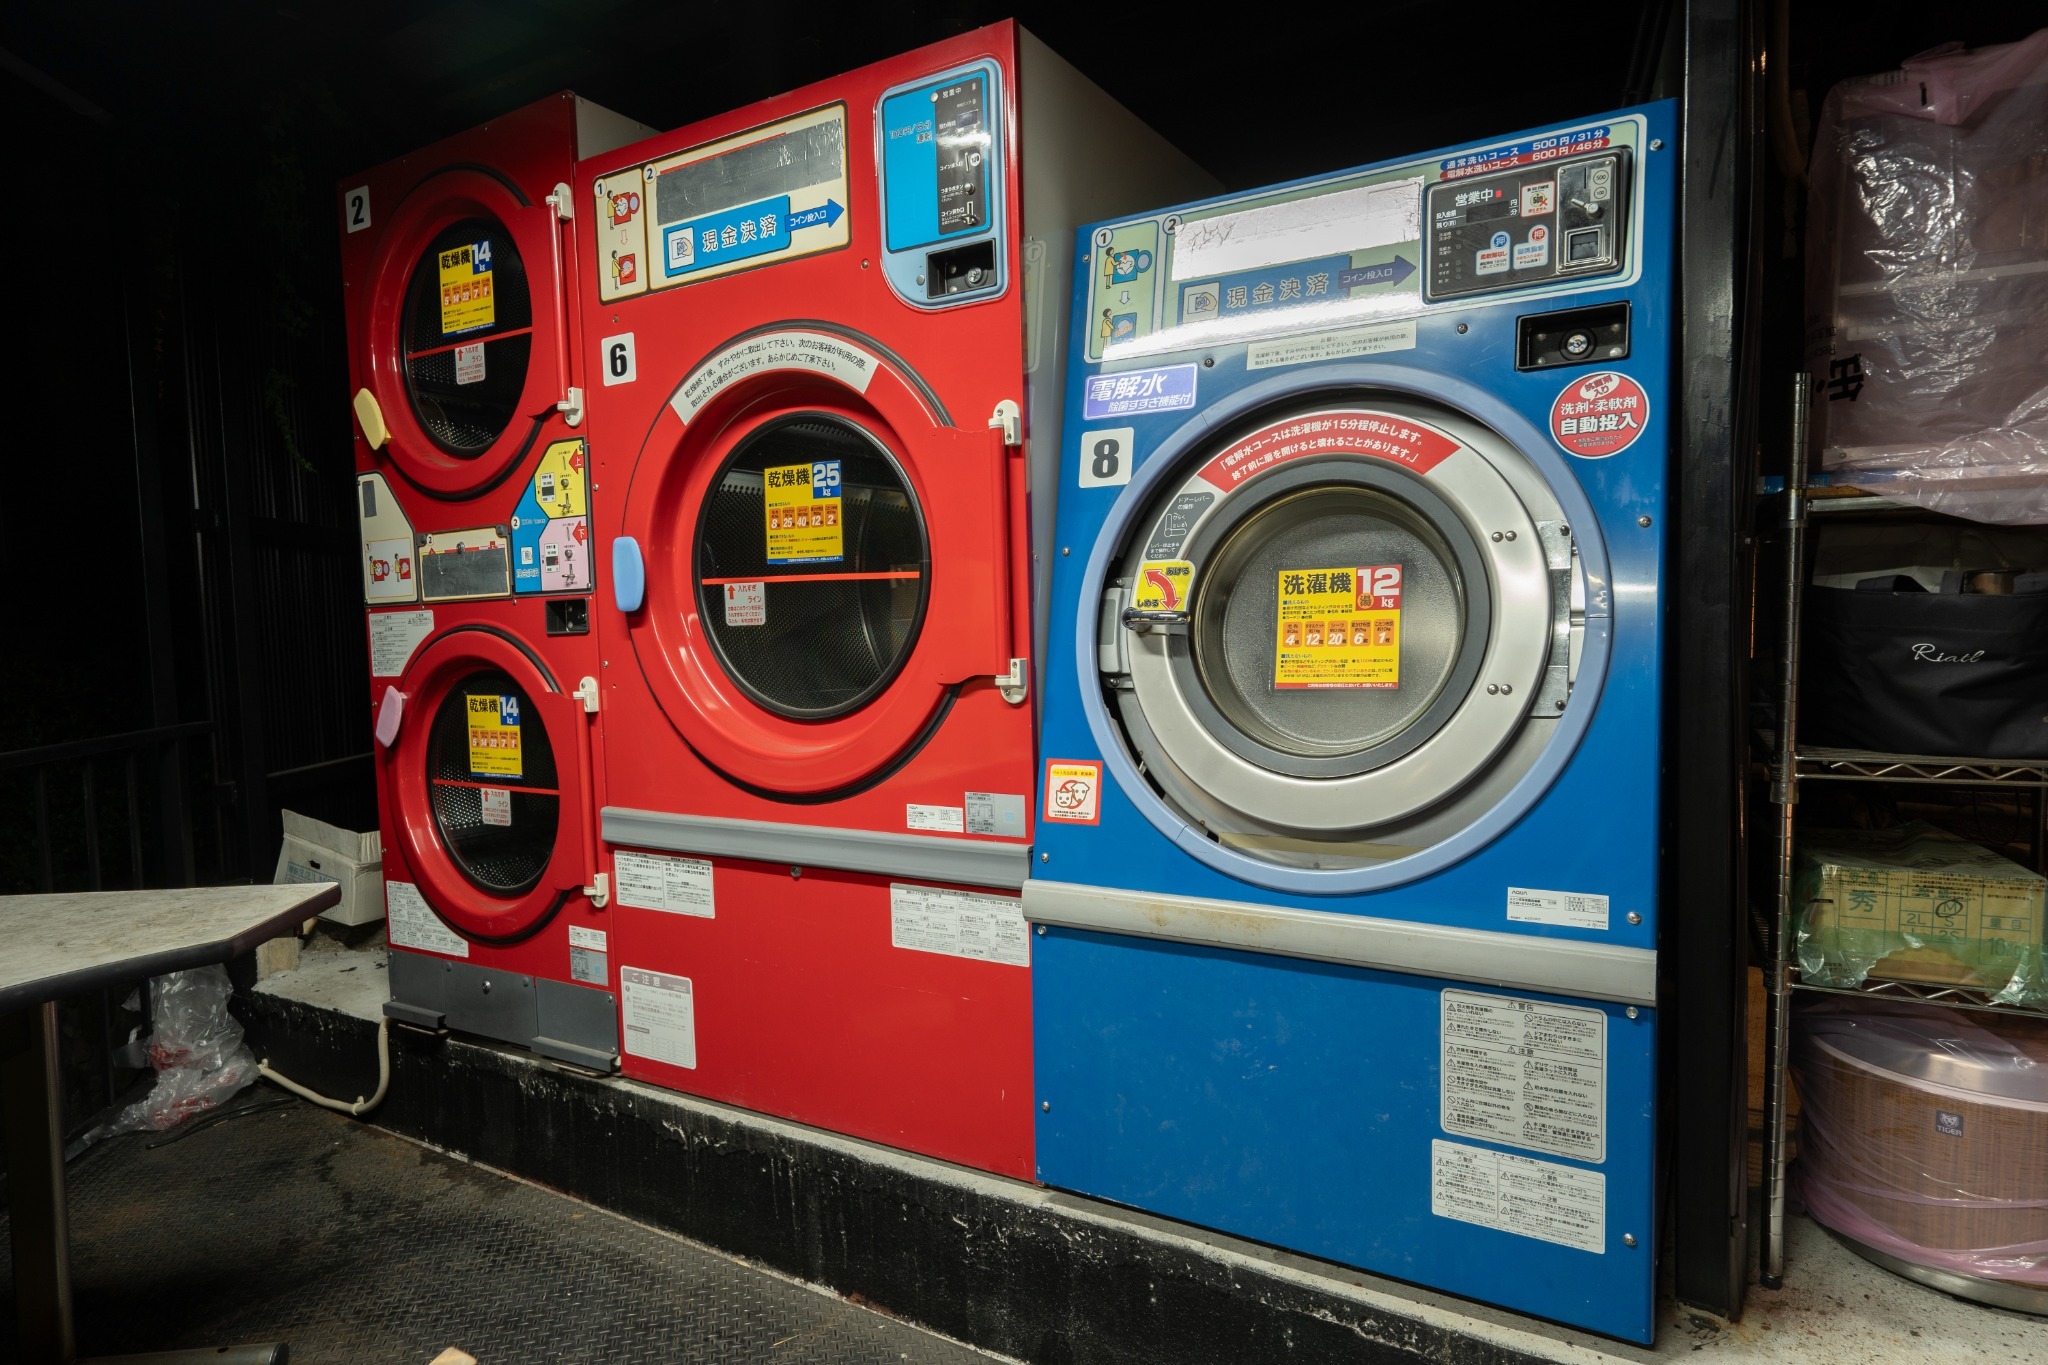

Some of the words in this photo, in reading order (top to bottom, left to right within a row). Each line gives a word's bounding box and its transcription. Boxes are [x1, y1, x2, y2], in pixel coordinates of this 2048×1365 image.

[1446, 146, 1519, 170] 通常洗いコース
[646, 169, 653, 180] 2
[1446, 156, 1519, 180] 電解水洗いコース
[597, 183, 603, 195] 1
[1455, 188, 1494, 207] 営業中
[352, 195, 364, 225] 2
[789, 210, 827, 228] コイン投入口
[703, 214, 777, 252] 現金決済
[1168, 218, 1177, 231] 2
[1101, 232, 1109, 244] 1
[441, 248, 471, 270] 乾燥機
[472, 241, 491, 265] 14
[1342, 267, 1394, 284] コイン投入口
[1226, 273, 1330, 308] 現金決済
[609, 343, 628, 378] 6
[1089, 373, 1168, 402] 電解水
[1594, 385, 1610, 397] 入り
[1107, 392, 1192, 413] 除菌すすぎ機能付
[1561, 396, 1637, 416] 洗剤・柔軟剤
[1560, 412, 1638, 436] 自動投入
[1220, 418, 1424, 472] 「電解水コースは洗濯機が15分程停止します。
[1092, 438, 1120, 479] 8
[1231, 435, 1421, 481] 終了前に扉を開けると壊れることがあります。」
[768, 468, 810, 488] 乾燥機
[813, 463, 840, 487] 25
[822, 487, 831, 496] kg
[1166, 566, 1190, 576] あける
[738, 584, 757, 592] 入れすぎ
[1283, 572, 1352, 595] 洗濯機
[1357, 567, 1400, 597] 12
[748, 595, 762, 604] ライン
[1137, 599, 1159, 608] しめる
[1381, 596, 1395, 608] kg
[469, 698, 499, 713] 乾燥機
[500, 697, 519, 716] 14
[1847, 891, 1878, 913] 秀
[1942, 900, 1958, 913] M
[1906, 912, 1927, 926] 2L
[1944, 915, 1955, 928] S
[1938, 929, 1960, 941] 2S
[1937, 1124, 1963, 1137] TIGER
